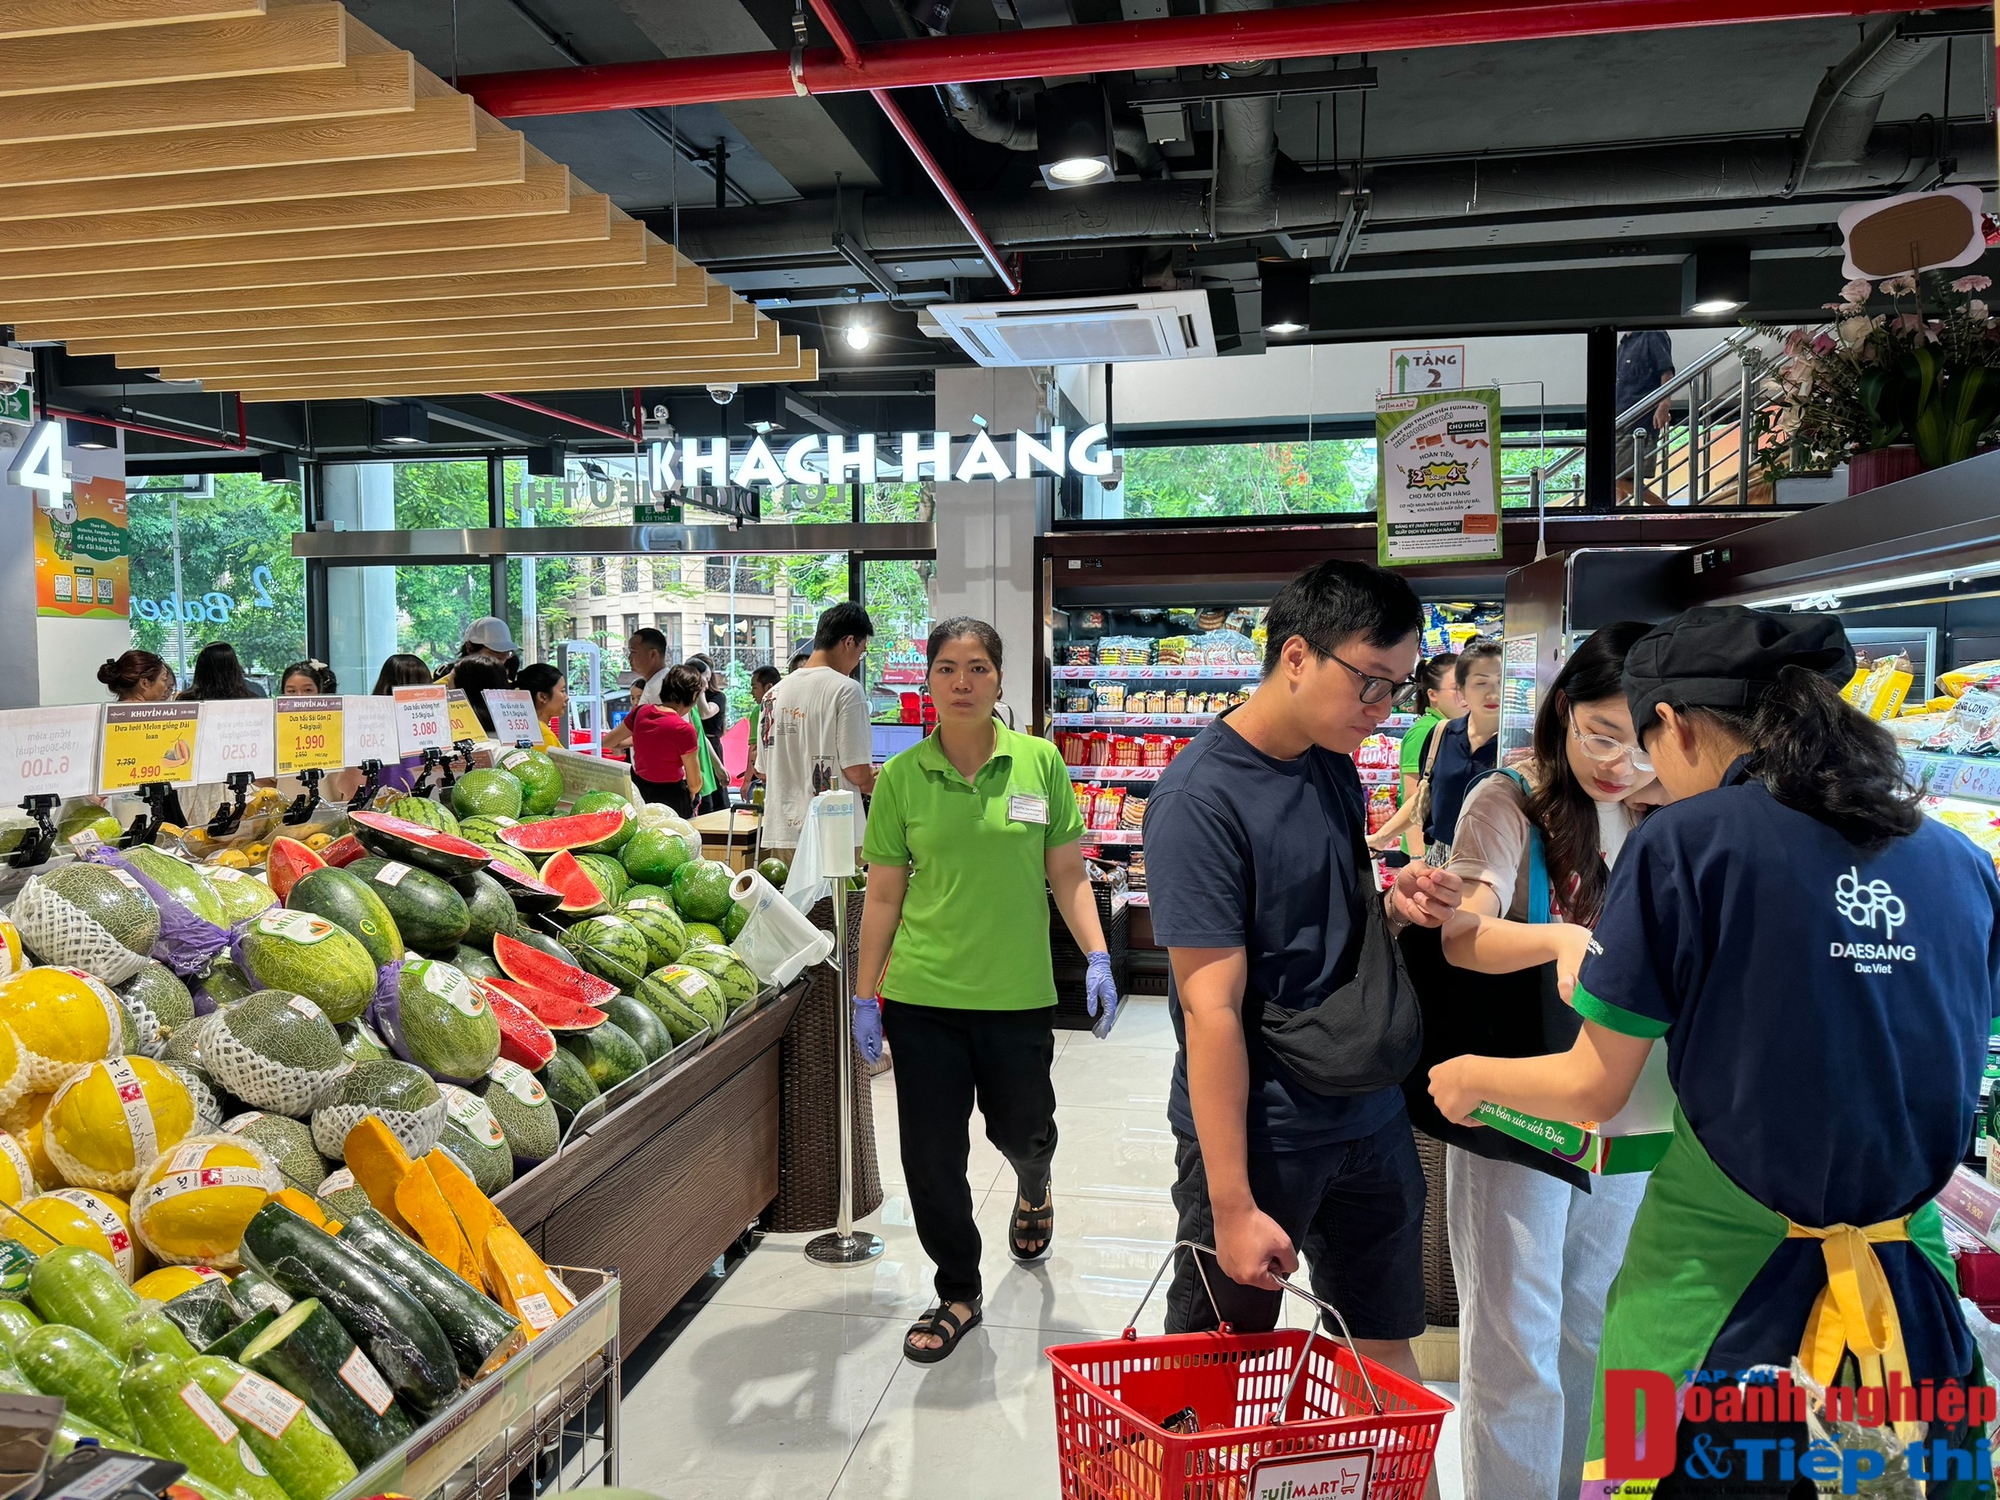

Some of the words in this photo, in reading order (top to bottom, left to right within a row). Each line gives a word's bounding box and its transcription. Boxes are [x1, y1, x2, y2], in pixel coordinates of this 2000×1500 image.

[1413, 350, 1457, 366] TẦNG
[1426, 368, 1442, 388] 2
[1414, 411, 1434, 424] THÀNH
[1449, 421, 1464, 430] CHỦ
[1464, 420, 1484, 428] NHẬT
[652, 421, 876, 491] KHÁCH
[901, 413, 1114, 484] HÀNG
[1420, 451, 1438, 460] HOÀN
[1440, 450, 1455, 458] TIỀN
[14, 420, 72, 509] 4
[131, 707, 162, 718] KHUYẾN
[162, 708, 177, 716] MÃI
[128, 723, 141, 731] lưới
[142, 722, 161, 730] Melon
[162, 721, 178, 730] giống
[412, 721, 437, 737] 3.080
[508, 719, 529, 730] 3.650
[295, 735, 325, 750] 1.990
[129, 765, 161, 779] 4.990
[1830, 942, 1916, 961] DAESANG
[1855, 963, 1872, 973] Duc
[1872, 963, 1892, 974] Viet
[1511, 1114, 1526, 1128] xúc
[1526, 1121, 1543, 1137] xích
[1545, 1126, 1565, 1145] Đức
[1966, 1202, 1983, 1219] 9.900
